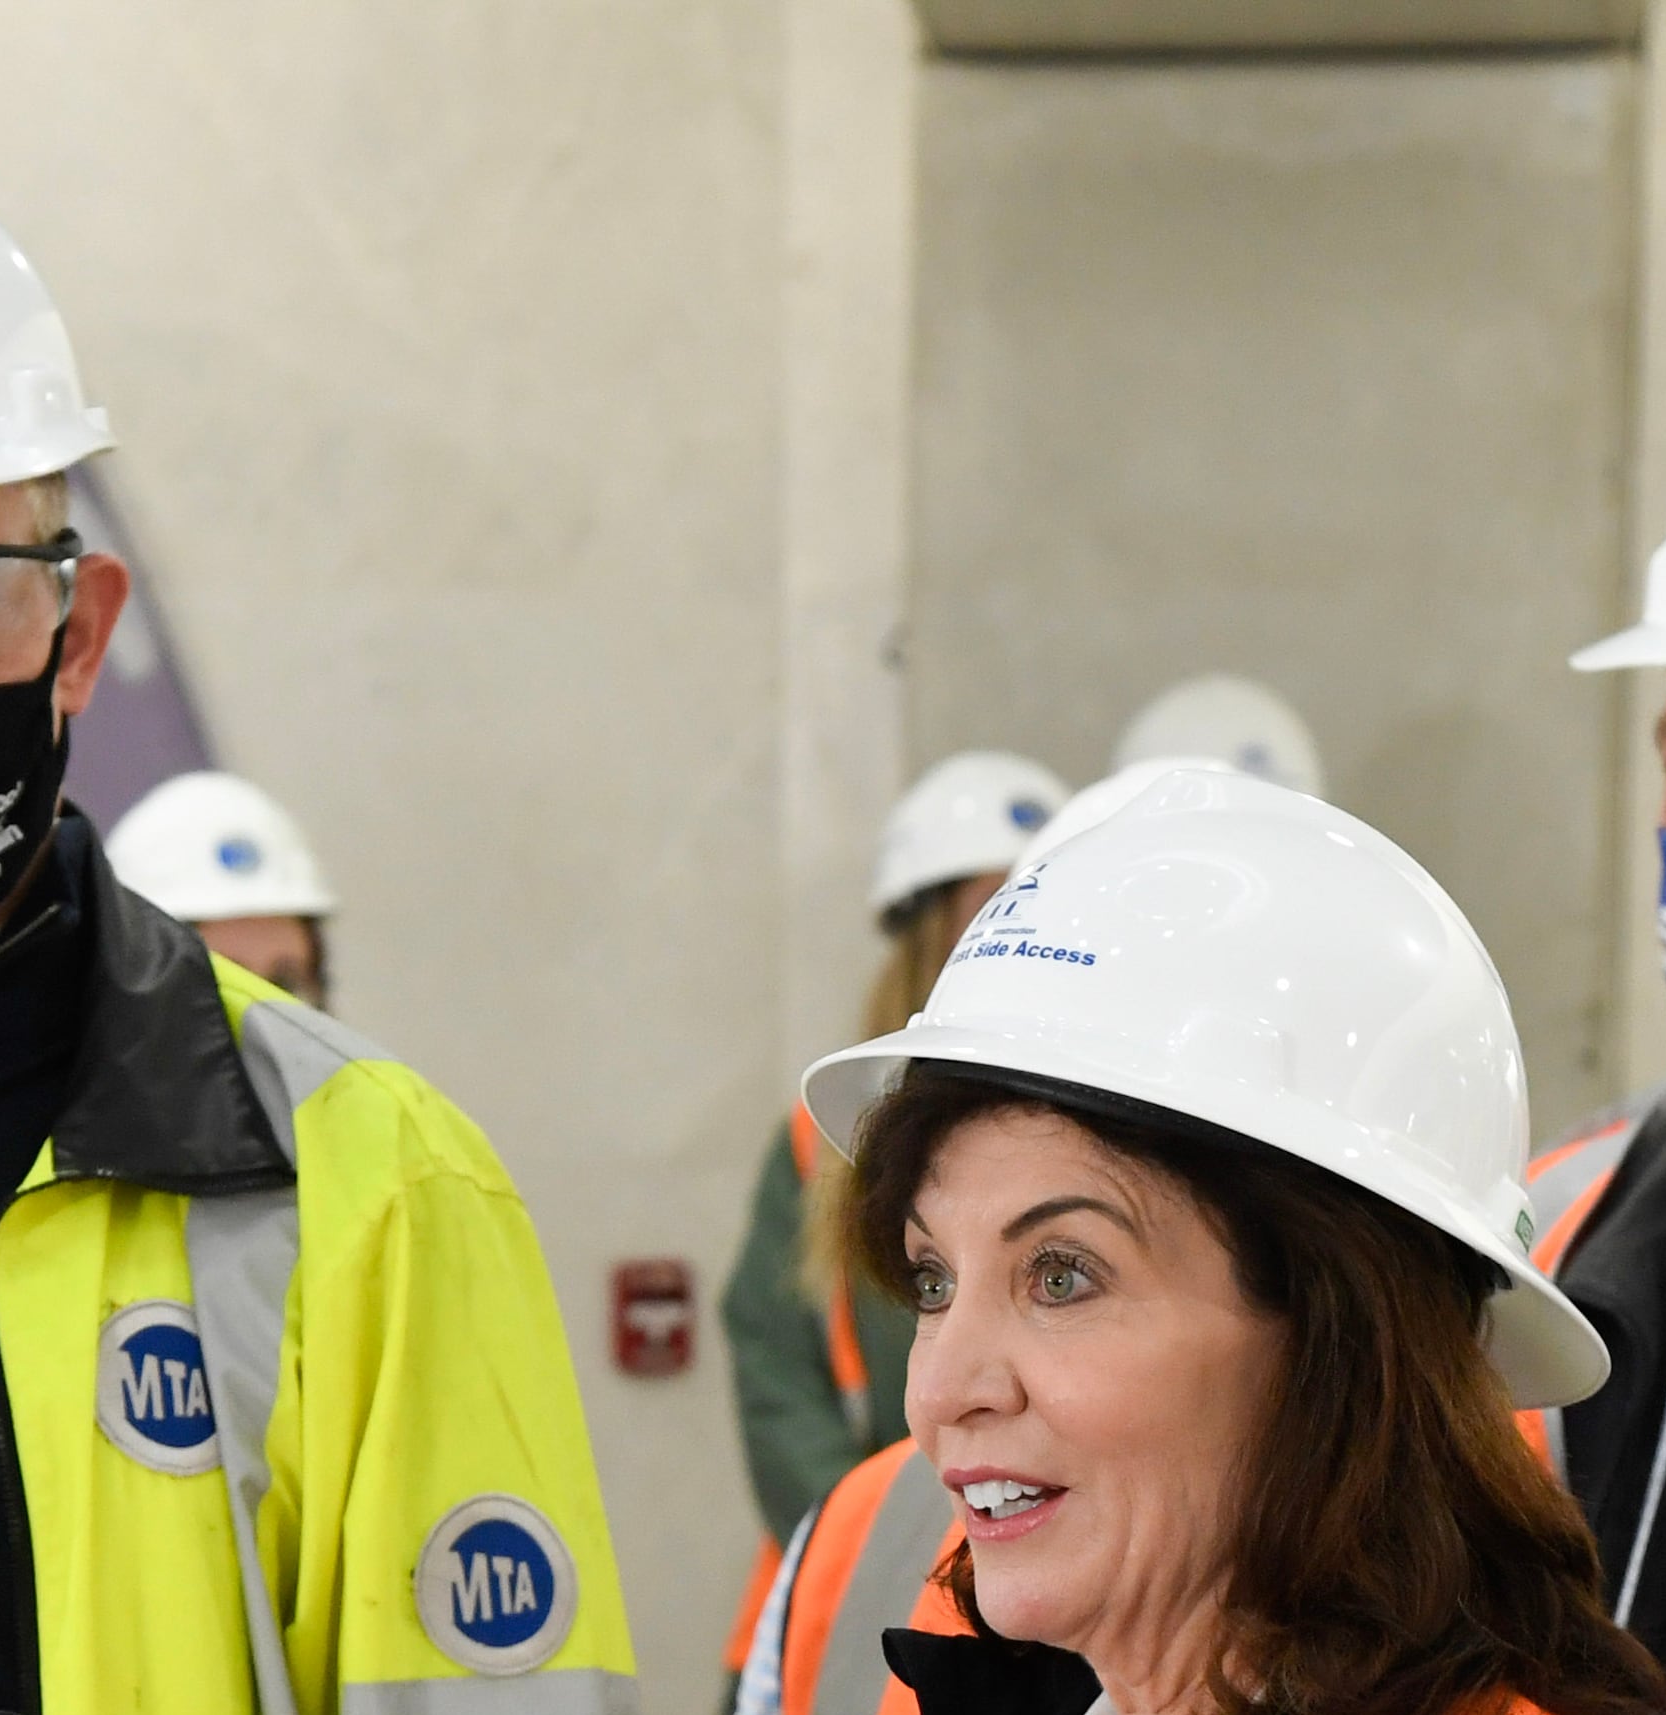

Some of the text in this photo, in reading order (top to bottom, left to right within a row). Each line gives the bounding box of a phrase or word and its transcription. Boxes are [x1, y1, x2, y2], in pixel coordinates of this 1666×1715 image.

[973, 940, 1010, 959] Side
[1012, 940, 1097, 966] Access
[121, 1352, 209, 1421] MTA
[449, 1550, 539, 1625] MTA
